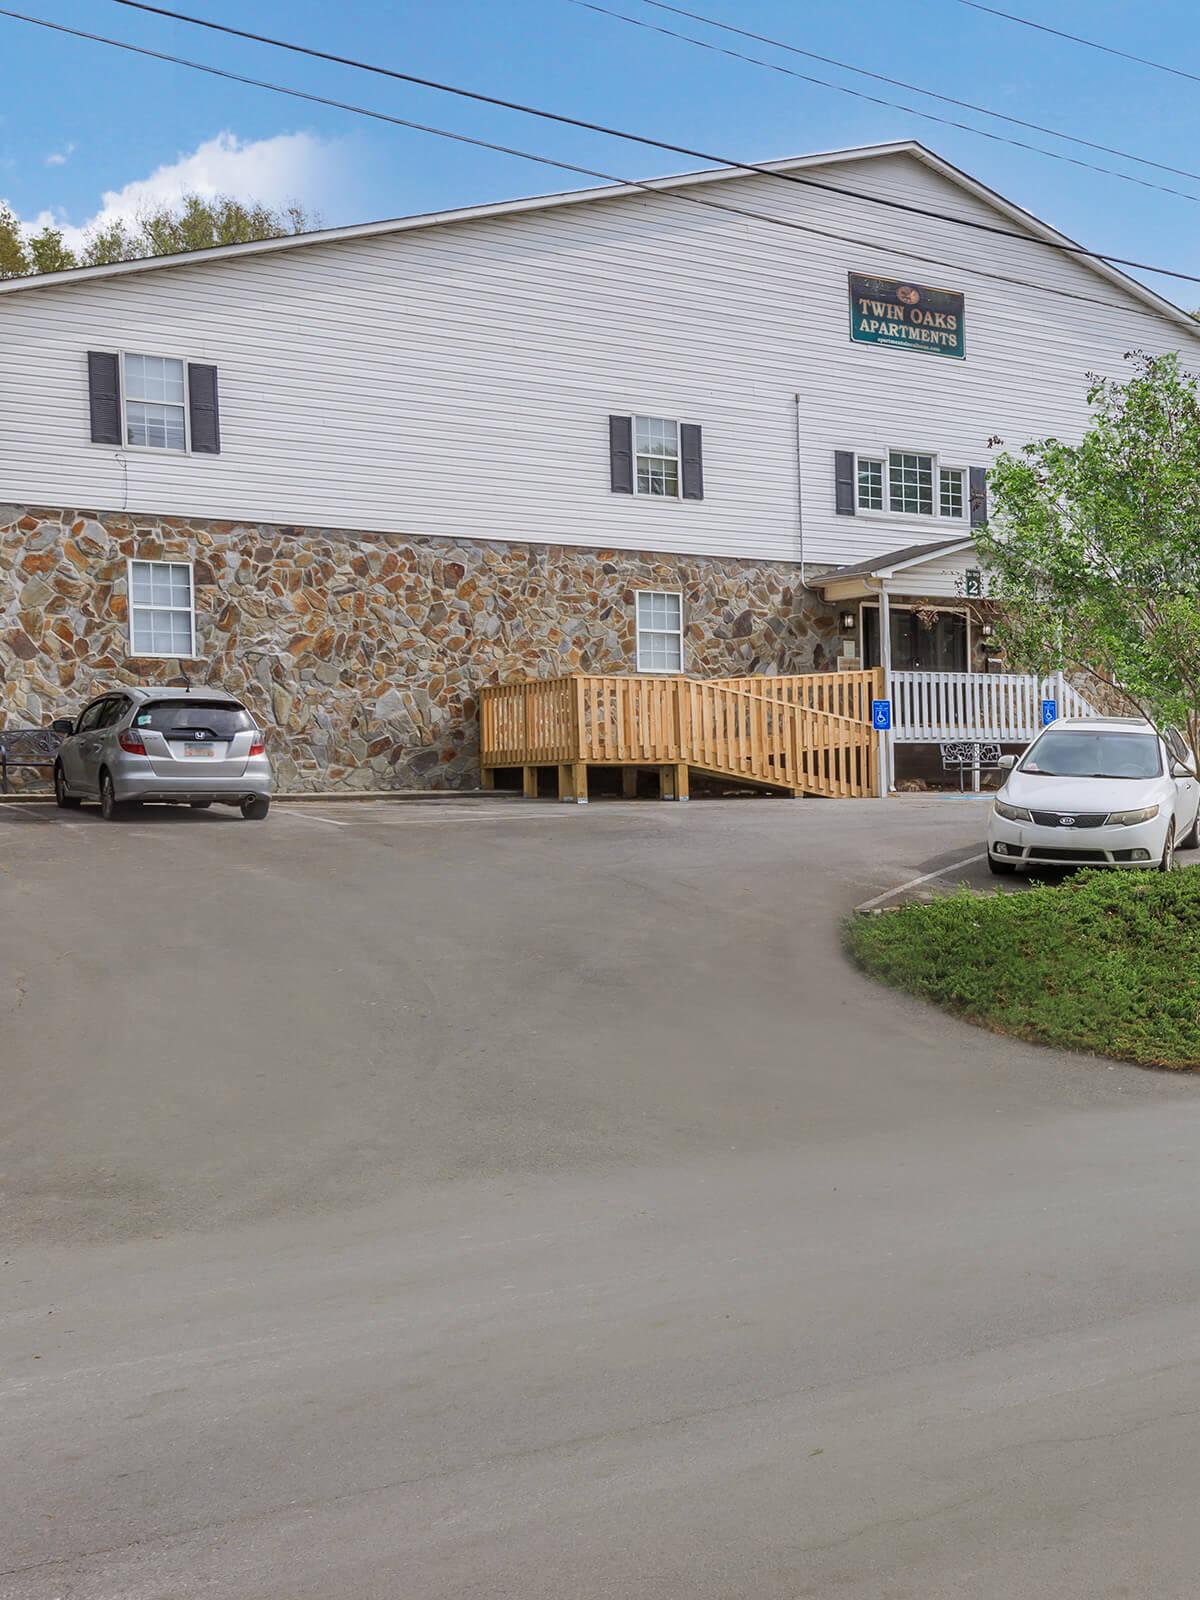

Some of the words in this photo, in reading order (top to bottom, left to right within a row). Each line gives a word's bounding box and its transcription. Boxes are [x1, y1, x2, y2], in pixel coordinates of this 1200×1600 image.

[859, 299, 904, 320] TWIN
[910, 308, 957, 330] OAKS
[860, 319, 957, 347] APARTMENTS
[969, 580, 978, 594] 2
